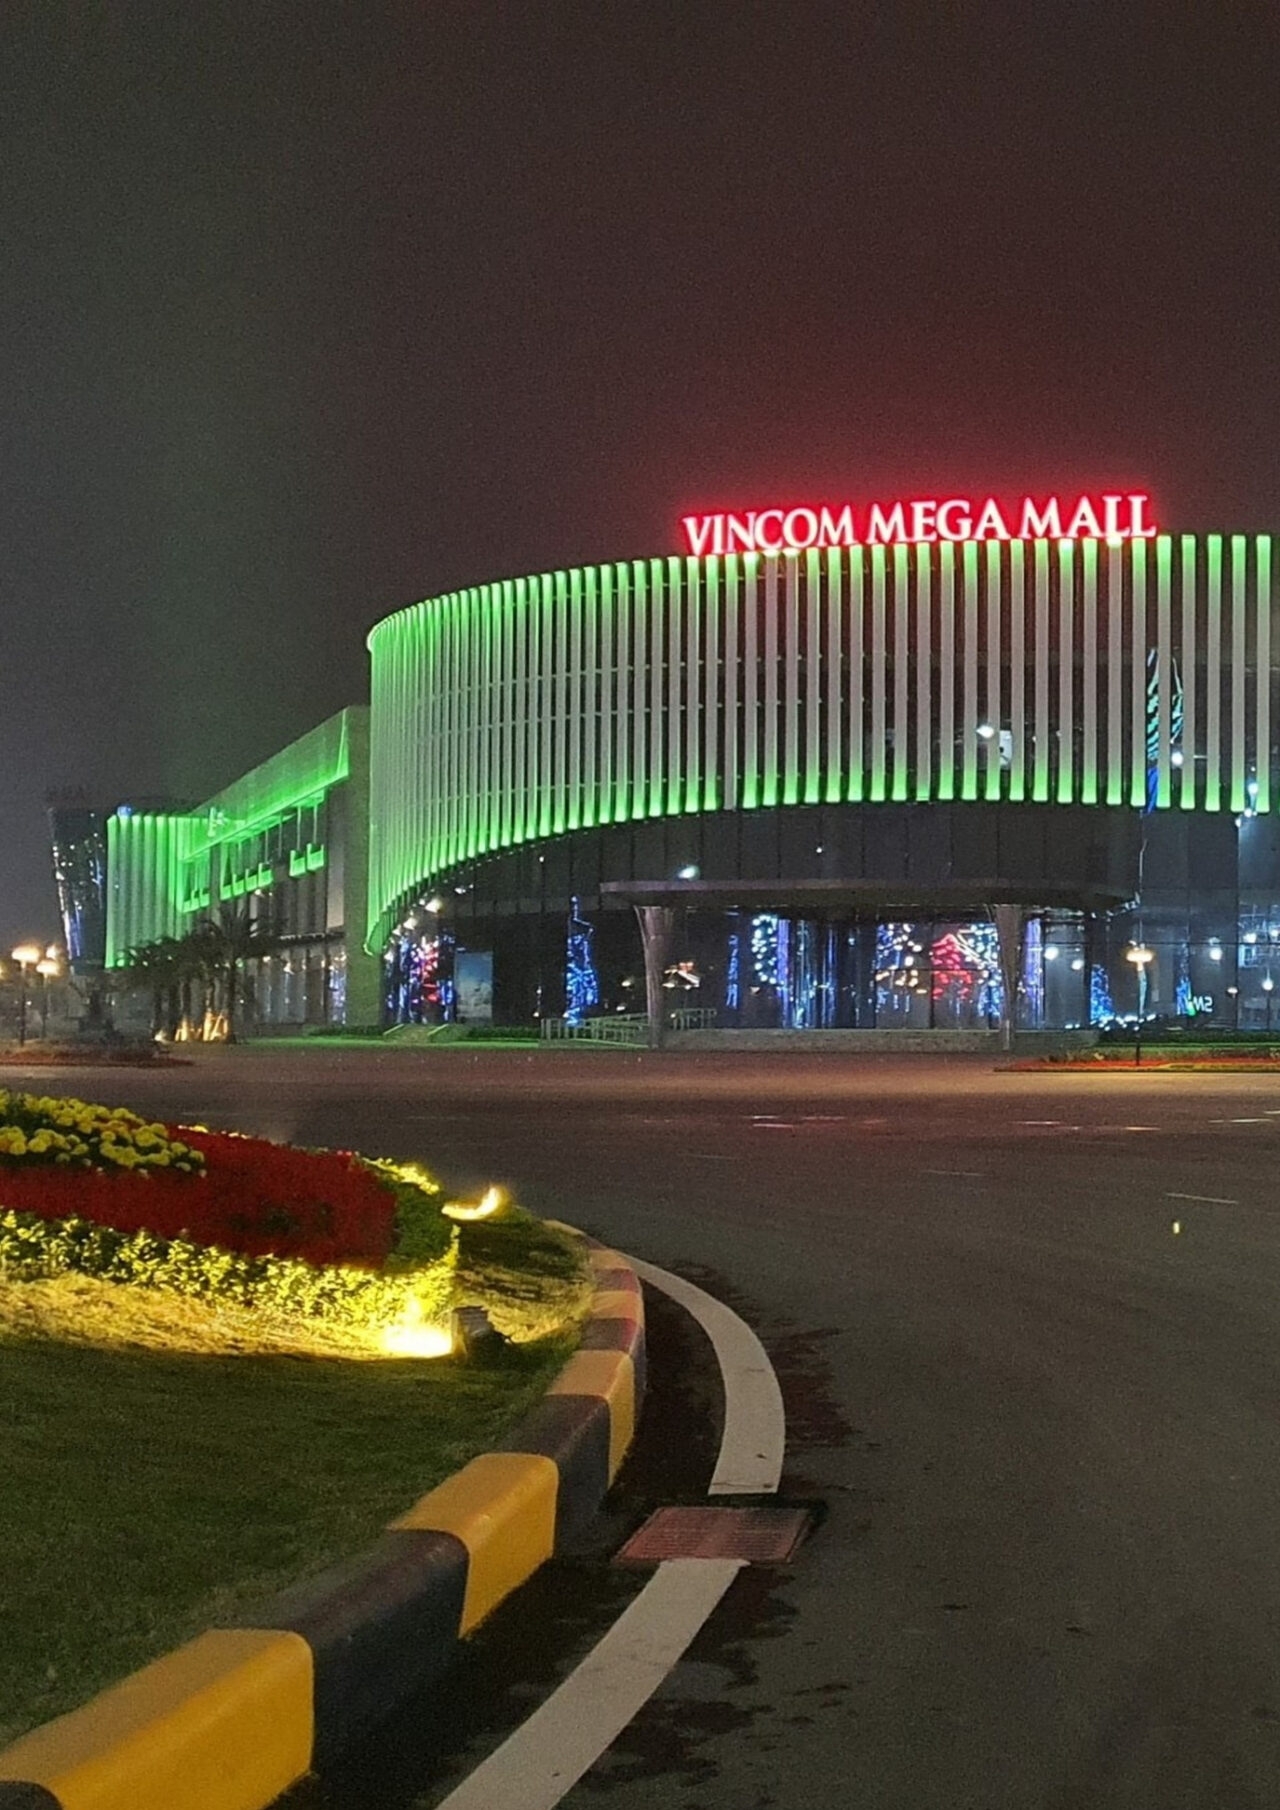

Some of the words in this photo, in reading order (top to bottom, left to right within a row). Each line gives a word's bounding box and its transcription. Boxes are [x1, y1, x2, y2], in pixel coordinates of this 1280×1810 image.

[683, 505, 856, 556] VINCOM
[866, 499, 1012, 543] MEGA
[1020, 495, 1157, 538] MALL
